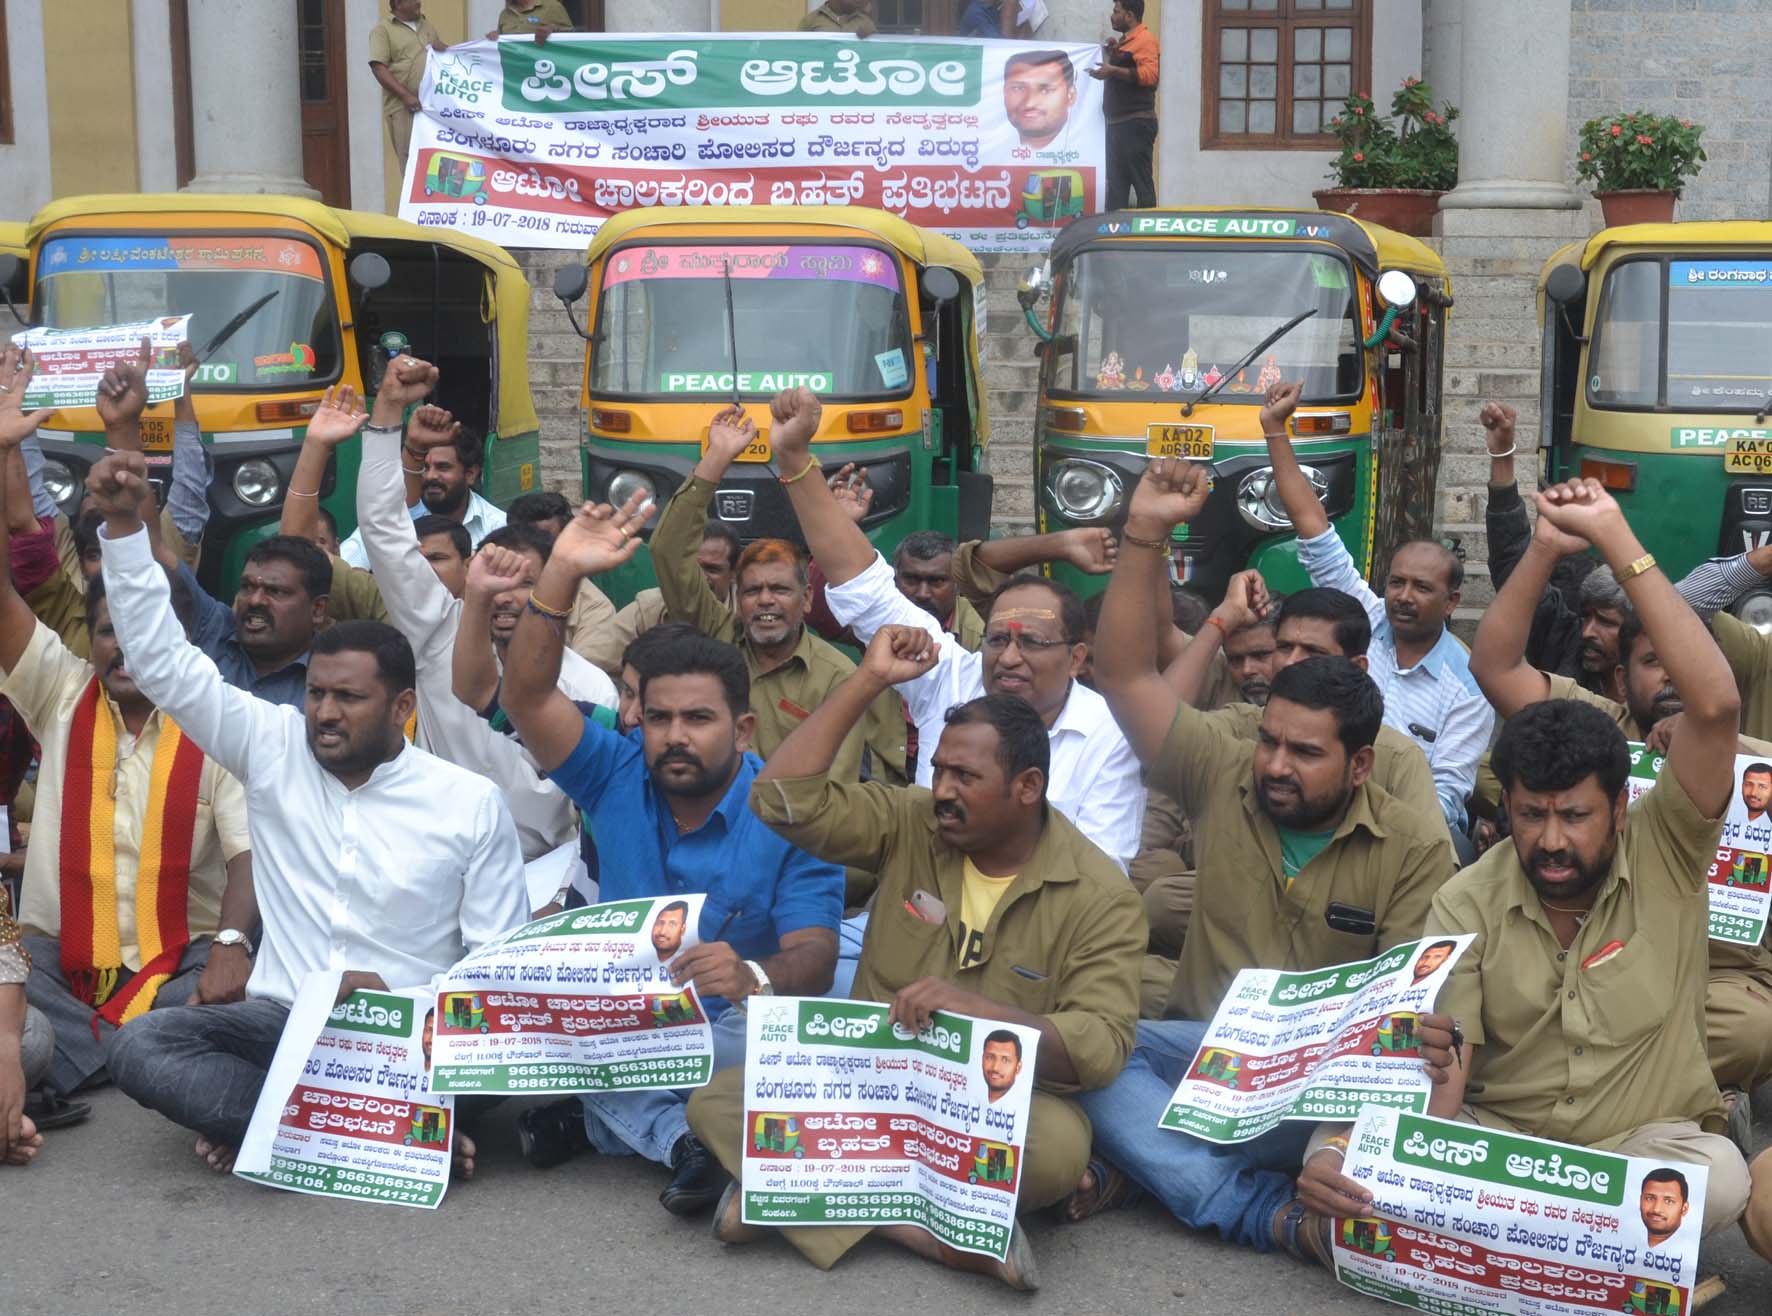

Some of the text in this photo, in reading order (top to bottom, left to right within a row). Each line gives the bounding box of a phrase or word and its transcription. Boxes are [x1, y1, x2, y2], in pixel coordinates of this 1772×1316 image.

[440, 70, 493, 93] PEACE
[520, 48, 967, 102] ಪೀಸ್ ಆಟೋ
[434, 84, 478, 104] AUTO
[496, 117, 554, 130] ಆಟೋ
[696, 112, 770, 130] ಶ್ರೀಯುತ
[830, 113, 876, 124] ರವರ
[548, 142, 600, 158] ನಗರ
[612, 142, 687, 161] ಸಂಚಾರಿ
[698, 137, 796, 160] ಪೋಲಿಸರ
[918, 136, 980, 168] ವಿರುದ್ಧ
[490, 166, 584, 204] ಆಟೋ
[594, 172, 754, 206] ಚಾಲಕರಿಂದ
[882, 169, 1012, 218] ಪ್ರತಿಭಟನೆ
[416, 208, 550, 231] ದಿನಾಂಕ 19-07-2018
[1138, 218, 1290, 235] PEACE AUTO
[640, 248, 670, 275] ಶ್ರೀ
[1688, 267, 1706, 282] ಶ್ರೀ
[1708, 268, 1768, 282] ರಂಗನಾಥ
[668, 374, 827, 392] PEACE AUTO
[1161, 428, 1180, 443] KA
[571, 908, 639, 930] ಆಟೋ
[1710, 913, 1754, 928] 66345
[1708, 924, 1751, 939] 41214
[494, 965, 516, 980] ನಗರ
[520, 964, 552, 982] ಸಂಚಾರಿ
[1236, 992, 1260, 1000] AUTO
[1241, 986, 1269, 996] PEACE
[1278, 973, 1340, 1000] ಪೀಸ್
[486, 992, 646, 1011] ಆಟೋ ಚಾಲಕರಿಂದ
[500, 1012, 640, 1034] ಬೃಹತ್ ಪ್ರತಿಭಟನೆ
[762, 1024, 794, 1033] PEACE
[805, 1013, 880, 1039] ಪೀಸ್
[489, 1036, 542, 1047] 19-07-2018
[760, 1034, 788, 1042] AUTO
[608, 1058, 703, 1074] 9663866345
[612, 1070, 702, 1086] 9060141214
[756, 1076, 817, 1099] ಬೆಂಗಳೂರು
[823, 1080, 852, 1100] ನಗರ
[858, 1080, 899, 1101] ಸಂಚಾರಿ
[302, 1090, 410, 1118] ಚಾಲಕರಿಂದ
[1305, 1089, 1415, 1104] 9663866345
[308, 1110, 396, 1135] ಪ್ರತಿಭಟನೆ
[804, 1113, 972, 1153] ಆಟೋ ಚಾಲಕರಿಂದ
[1358, 1143, 1382, 1156] AUTO
[1360, 1134, 1390, 1148] PEACE
[817, 1134, 960, 1171] ಬೃಹತ್ ಪ್ರತಿಭಟನೆ
[1402, 1131, 1610, 1194] ಪೀಸ್ ಆಟೋ
[804, 1164, 866, 1173] 19-07-2018
[336, 1170, 434, 1193] 9663866345
[333, 1182, 429, 1203] 9060141214
[1476, 1189, 1516, 1210] ಶ್ರೀಯುತ
[1520, 1198, 1539, 1216] ರಘು
[1544, 1203, 1568, 1220] ರವರ
[1414, 1206, 1446, 1228] ನಗರ
[1452, 1214, 1500, 1240] ಸಂಚಾರಿ
[1506, 1223, 1570, 1252] ಪೋಲಿಸರ
[1642, 1249, 1682, 1284] ವಿರುದ್ಧ
[1396, 1226, 1626, 1288] ಆಟೋ ಚಾಲಕರಿಂದ
[1394, 1267, 1459, 1290] 19-07-2018
[1410, 1248, 1608, 1302] ಬೃಹತ್ ಪ್ರತಿಭಟನೆ
